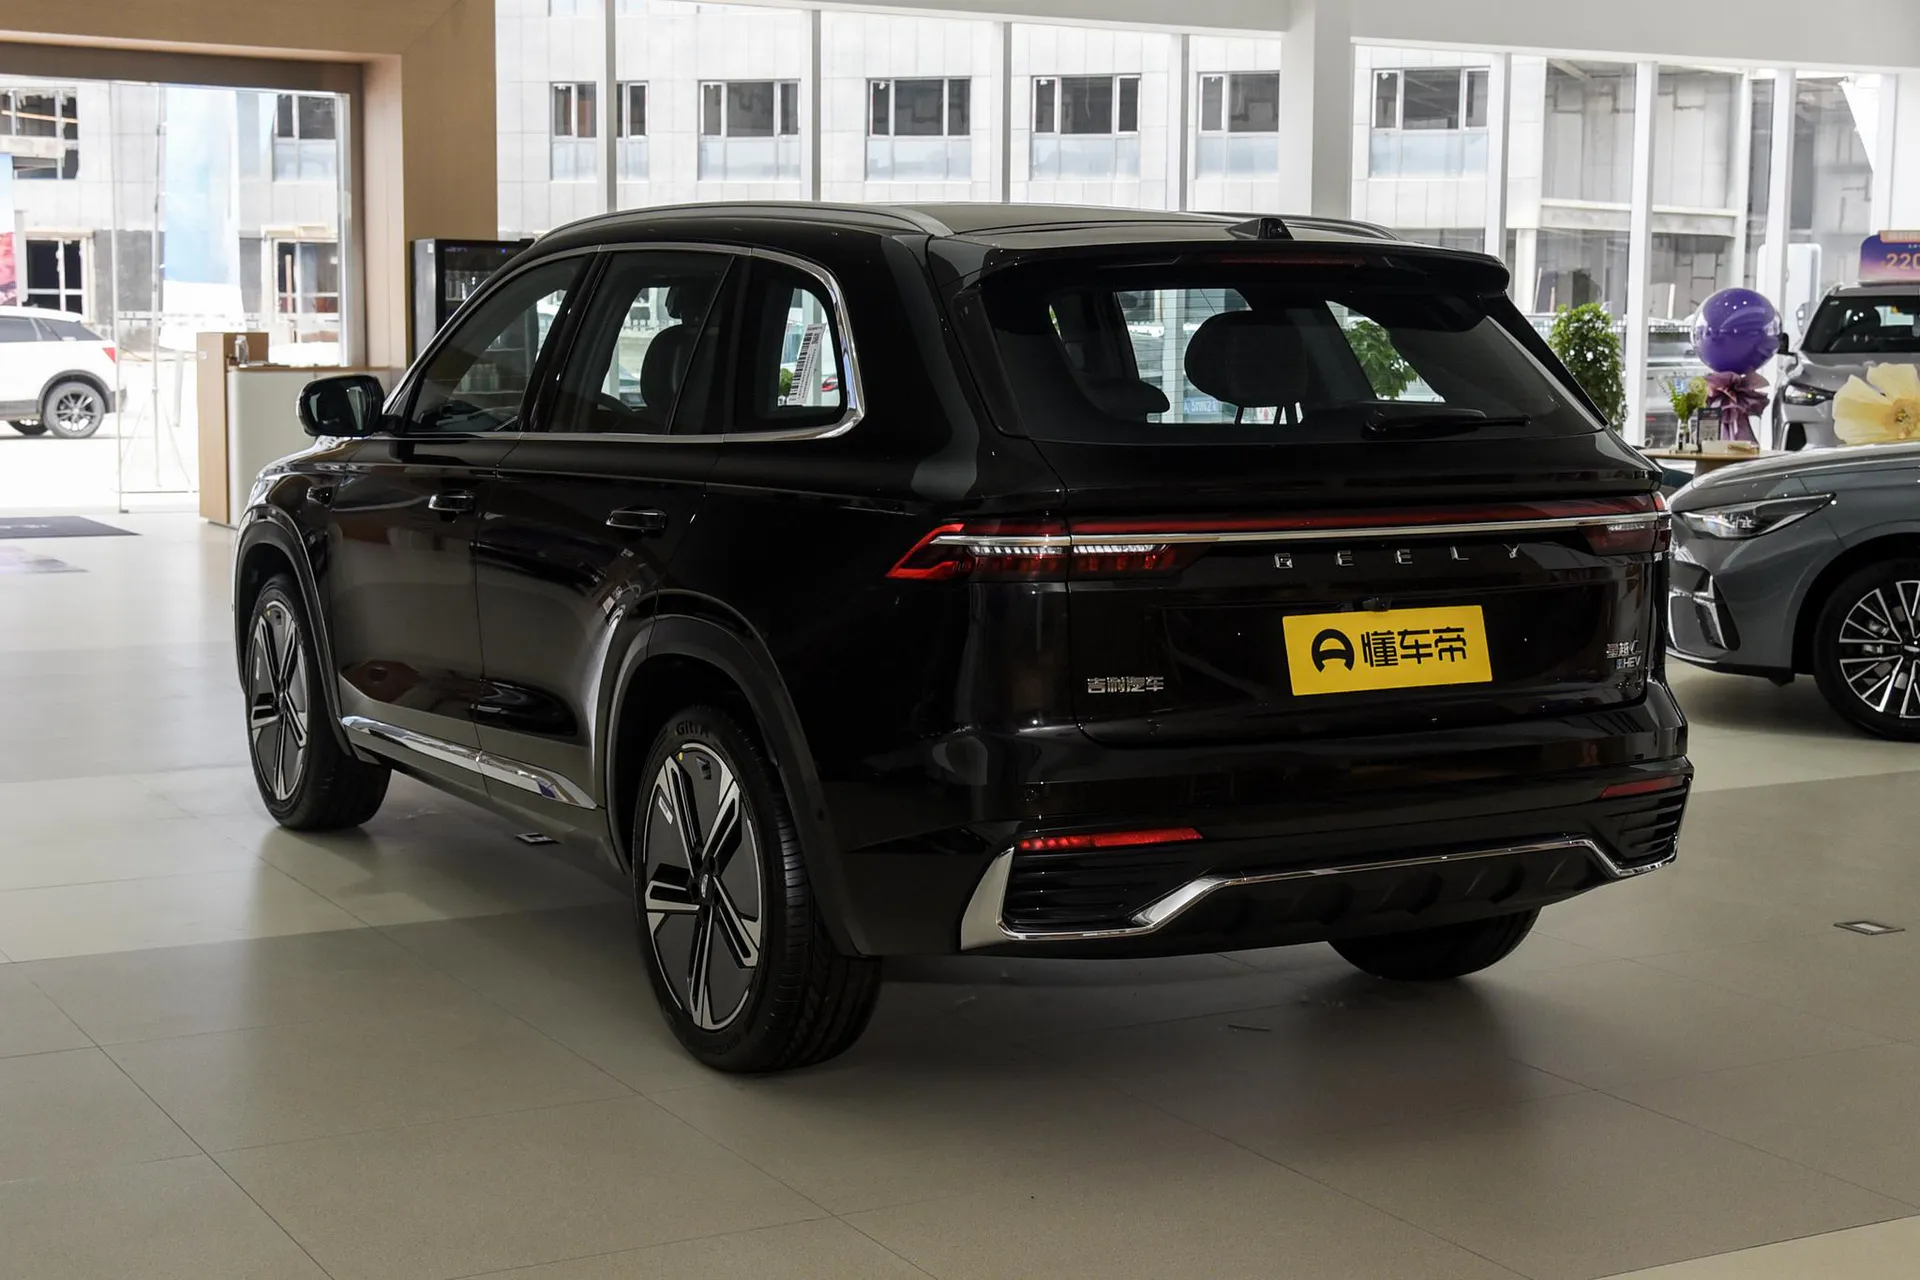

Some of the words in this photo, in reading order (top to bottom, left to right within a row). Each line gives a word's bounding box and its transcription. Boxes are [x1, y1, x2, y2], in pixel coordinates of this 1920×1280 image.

[1274, 543, 1520, 569] GEELY
[1361, 626, 1467, 667] 懂车帝
[1087, 676, 1164, 693] 吉利汽车
